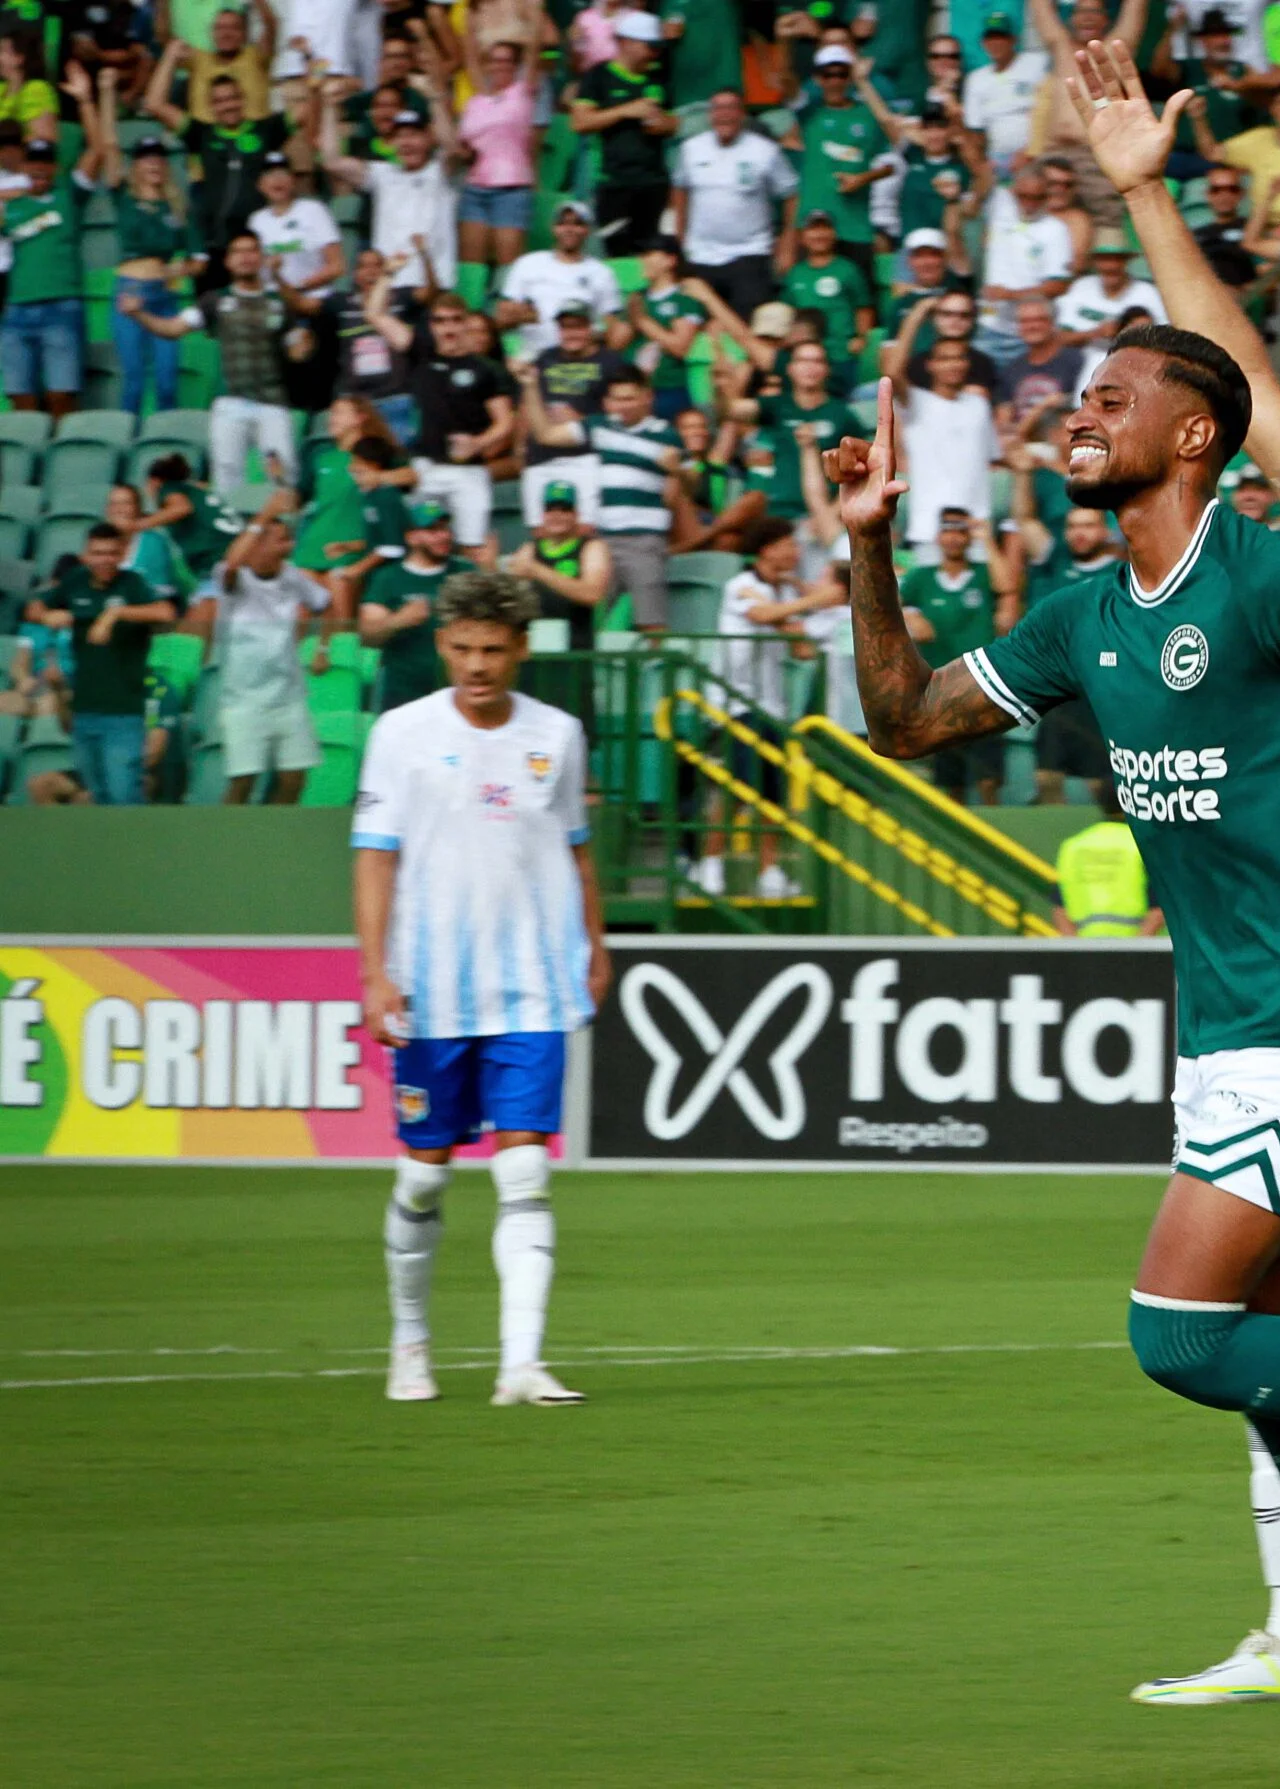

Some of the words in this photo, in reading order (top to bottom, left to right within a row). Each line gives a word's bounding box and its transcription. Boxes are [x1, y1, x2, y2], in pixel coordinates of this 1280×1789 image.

[1170, 636, 1200, 678] G
[82, 996, 363, 1110] CRIME
[838, 1115, 989, 1153] Respeito
